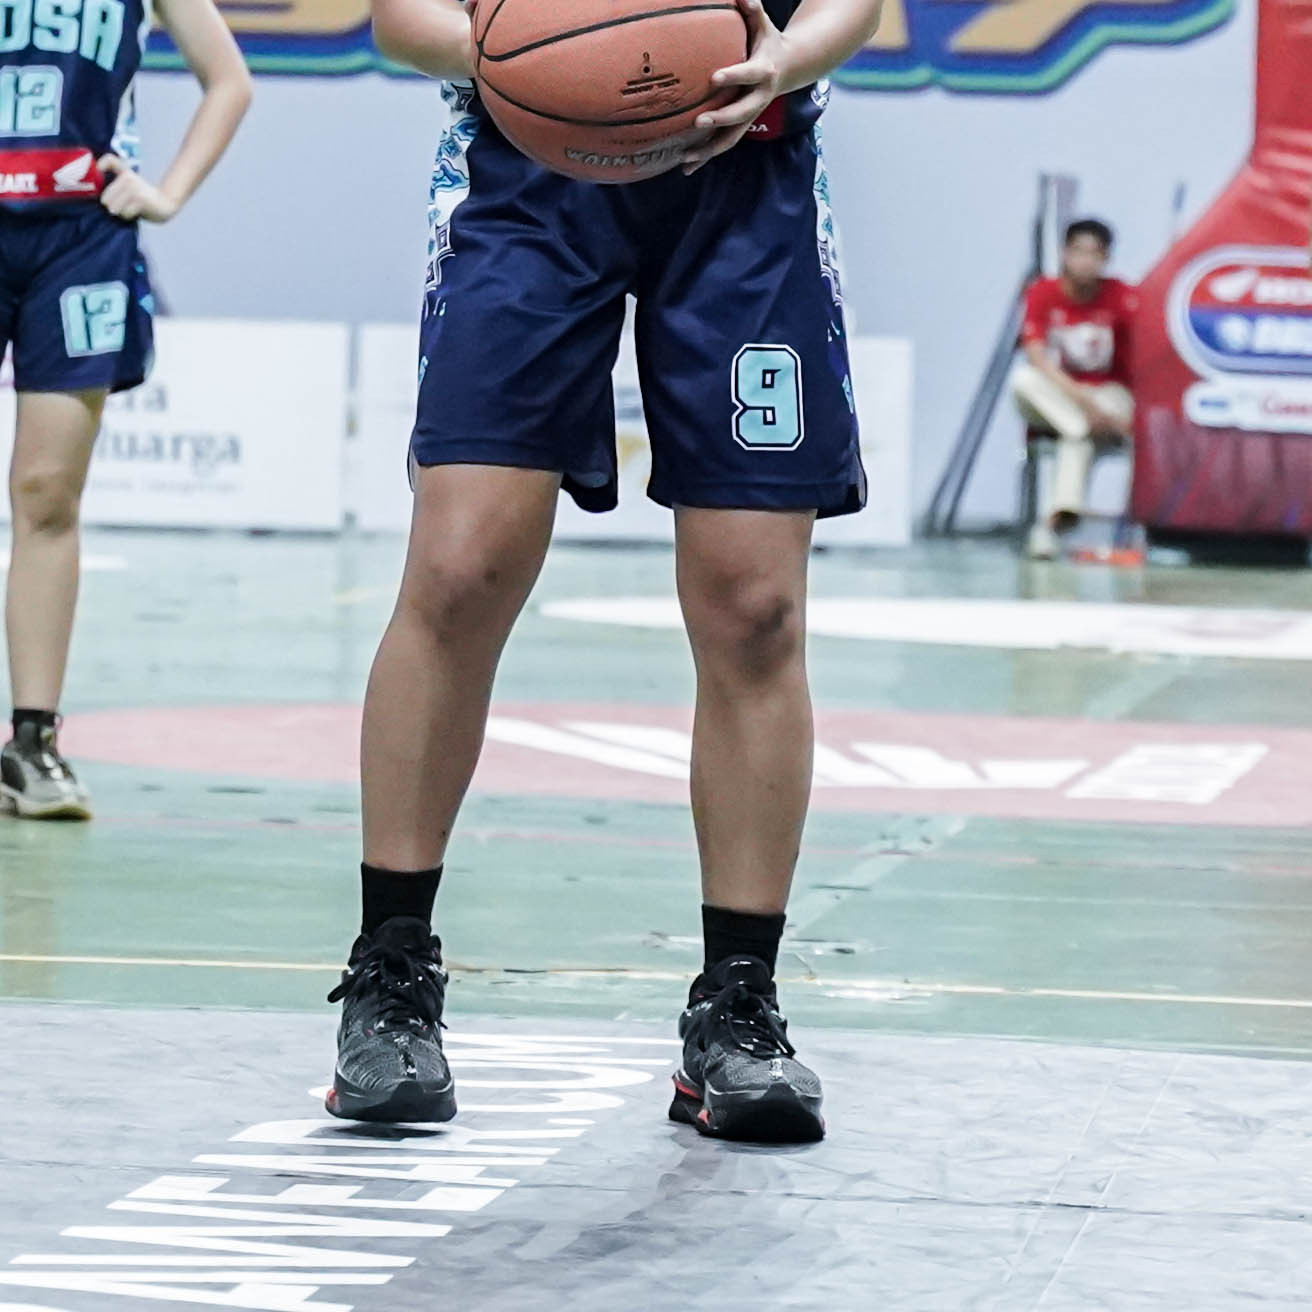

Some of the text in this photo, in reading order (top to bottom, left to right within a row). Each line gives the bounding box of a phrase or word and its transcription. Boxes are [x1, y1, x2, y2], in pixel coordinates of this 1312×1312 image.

[59, 279, 130, 358] 12
[730, 342, 806, 452] 9
[97, 423, 243, 478] uarga
